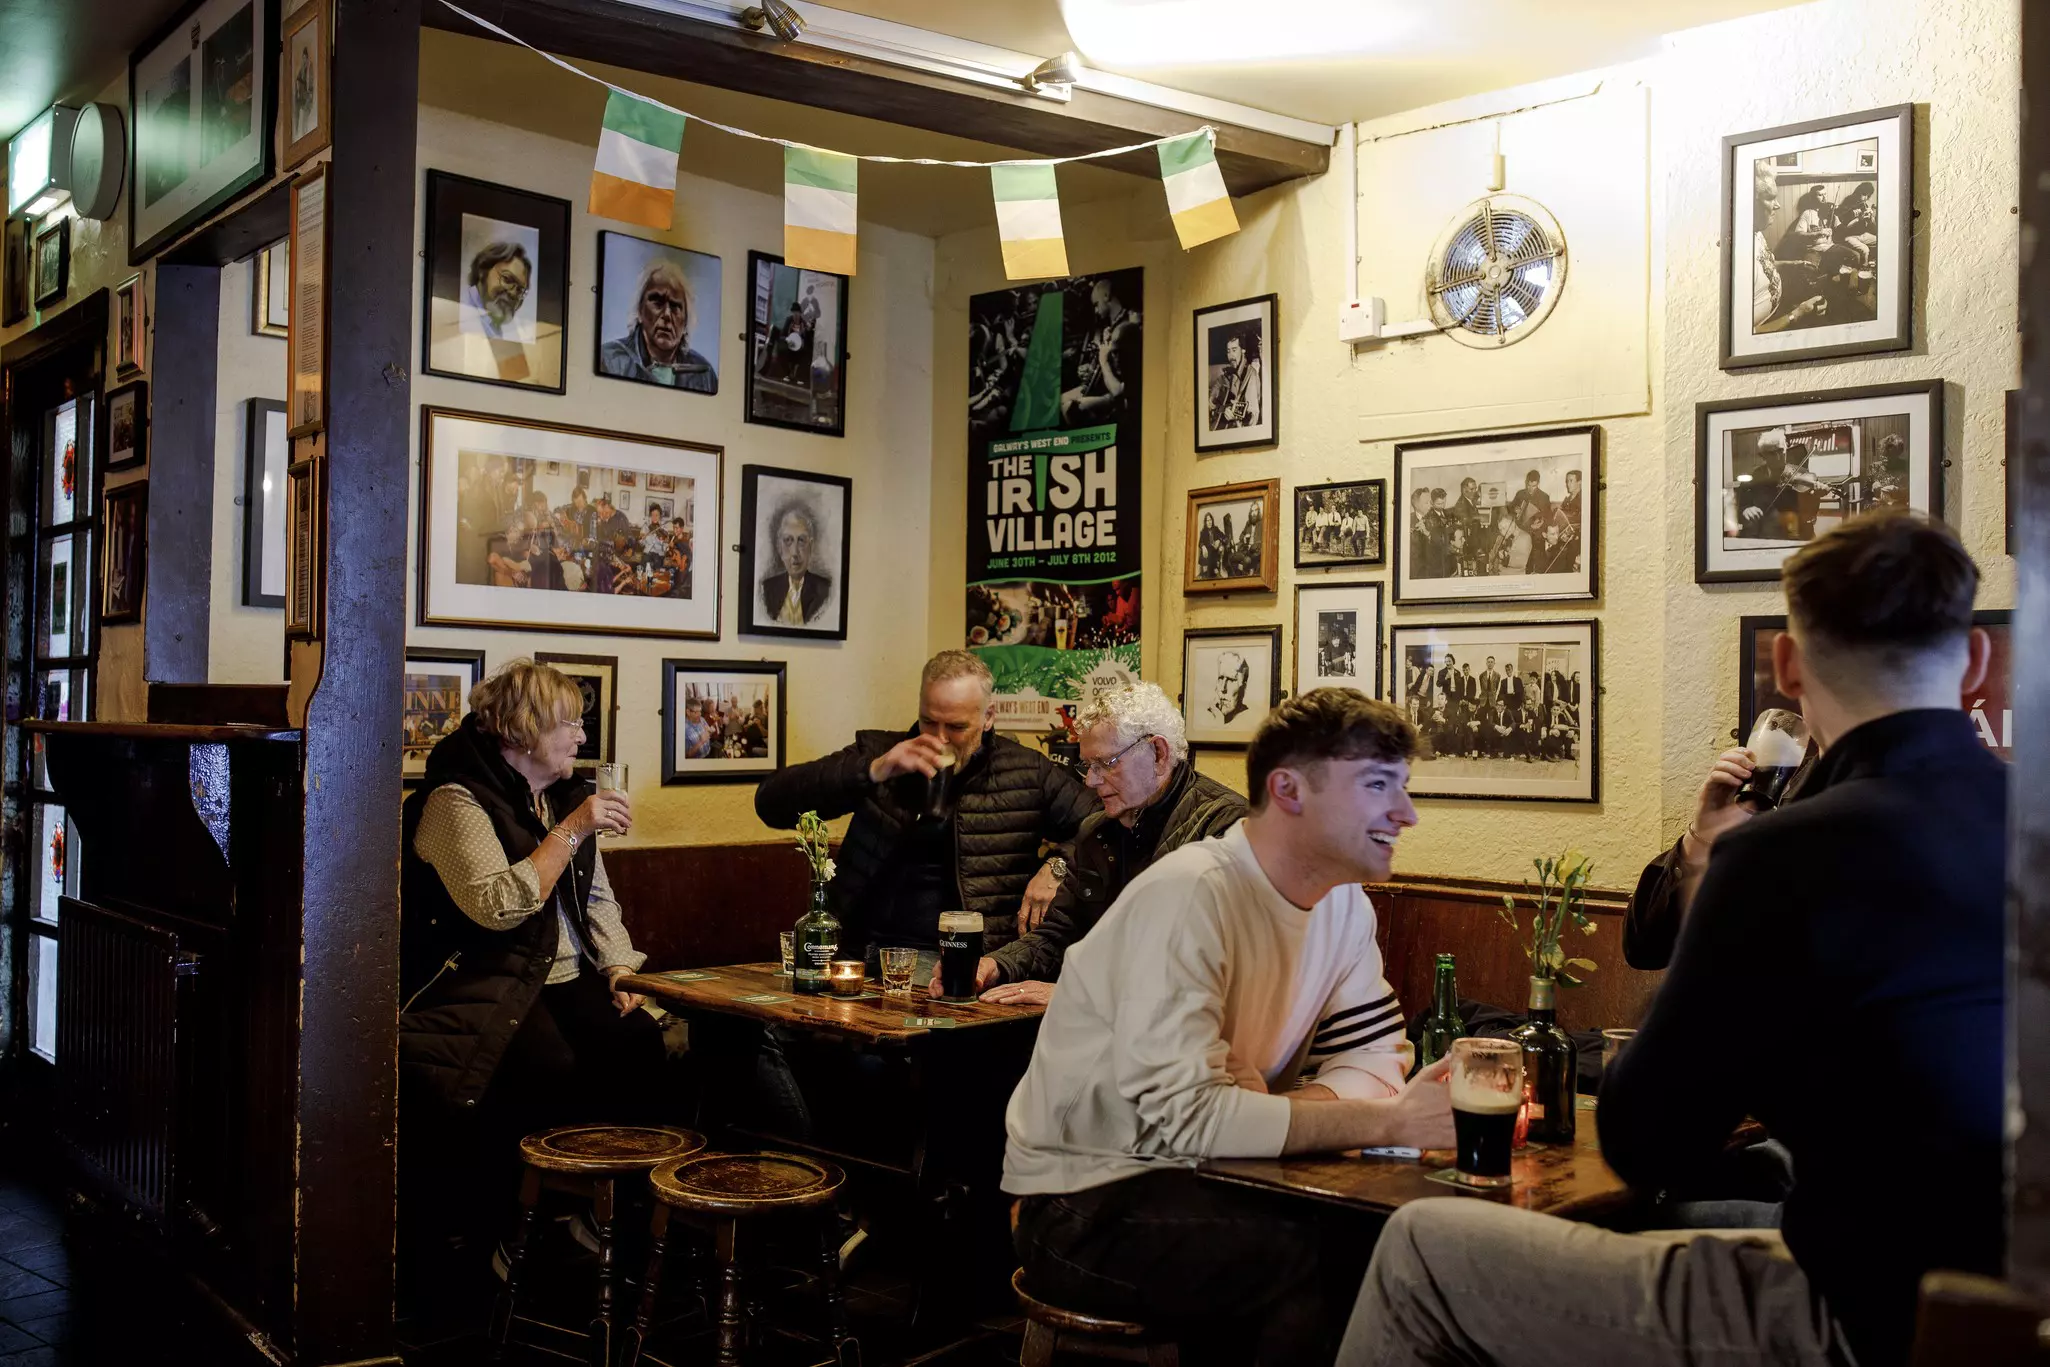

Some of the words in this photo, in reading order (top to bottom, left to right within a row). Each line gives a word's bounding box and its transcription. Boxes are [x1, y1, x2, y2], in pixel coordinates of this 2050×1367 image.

[993, 440, 1029, 453] GALWAY'S
[1030, 438, 1052, 449] WEST
[1053, 436, 1069, 446] END
[1071, 432, 1111, 444] PRESENTS
[988, 455, 1032, 478] THE
[987, 445, 1117, 516] IRISH
[987, 510, 1117, 553] VILLAGE
[987, 557, 1009, 569] JUNE
[1012, 556, 1036, 568] 30TH
[1047, 554, 1069, 566] JULY
[1072, 553, 1091, 564] 8TH
[1093, 551, 1116, 563] 2012
[1092, 676, 1117, 686] VOLVO
[994, 701, 1018, 714] LWAY'S
[1037, 701, 1050, 714] END
[1050, 753, 1070, 766] GLE
[939, 940, 968, 949] GUINNESS
